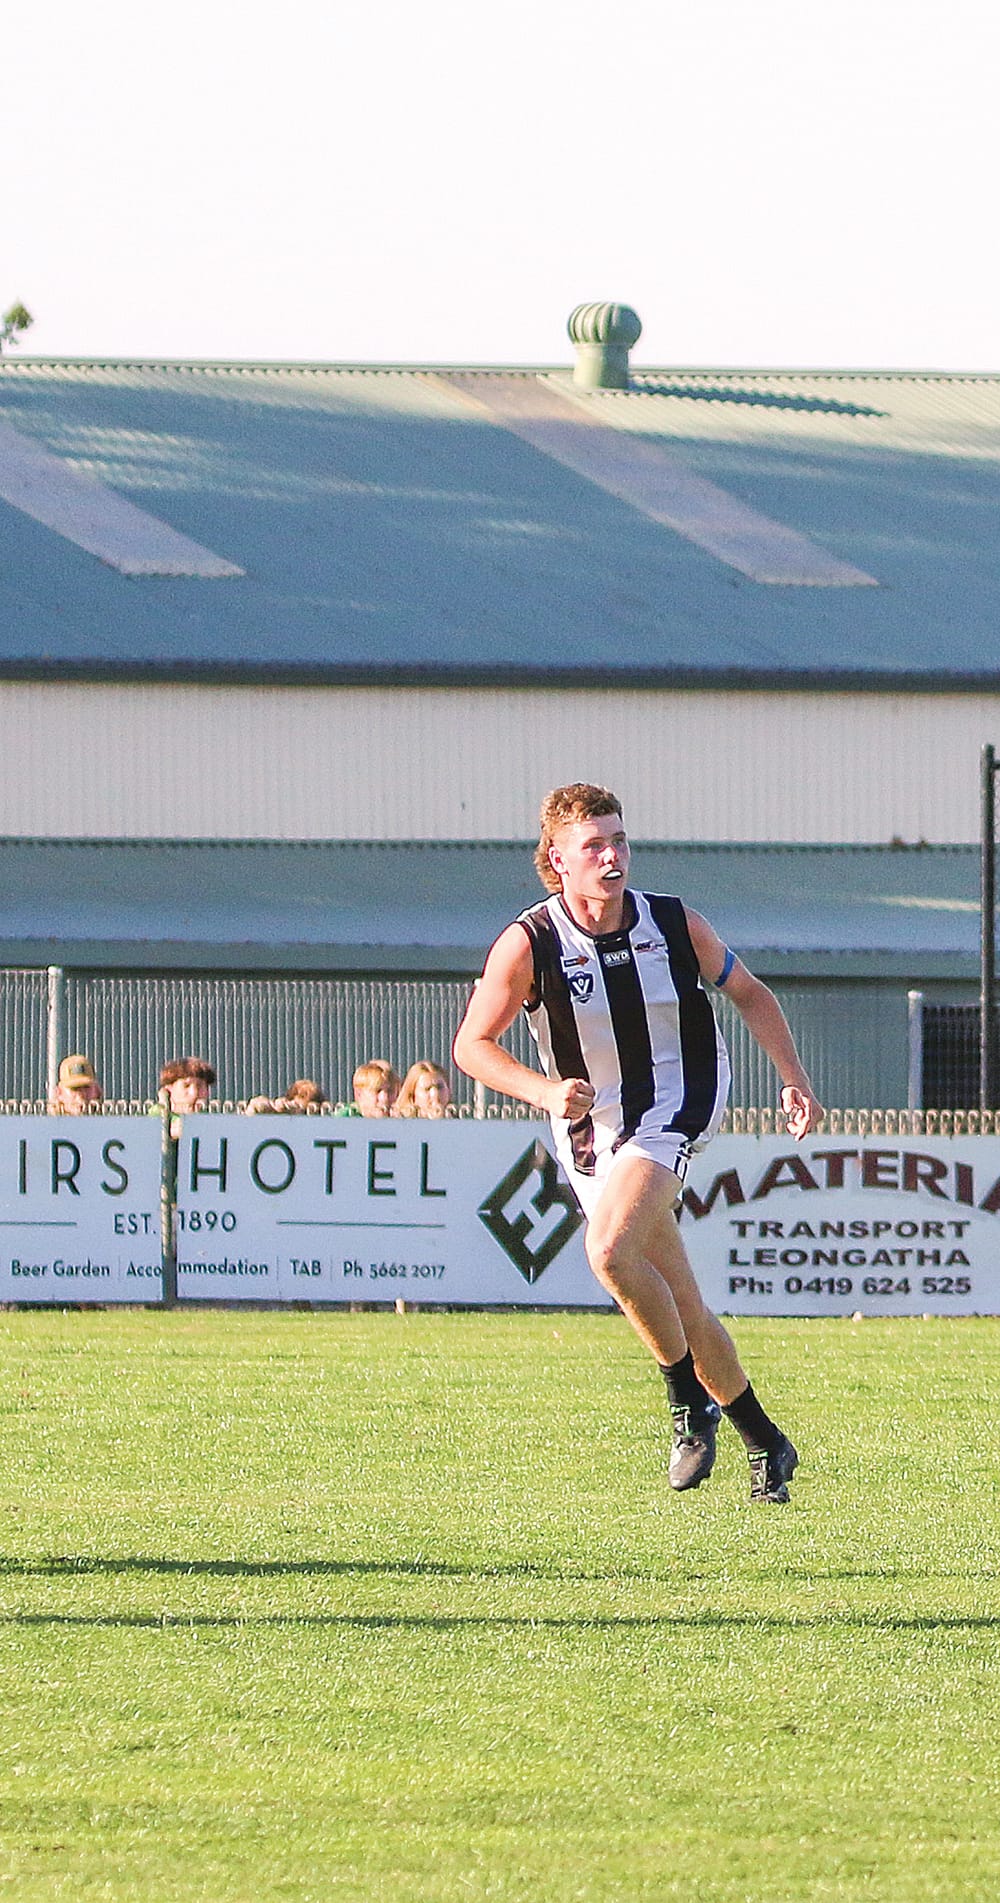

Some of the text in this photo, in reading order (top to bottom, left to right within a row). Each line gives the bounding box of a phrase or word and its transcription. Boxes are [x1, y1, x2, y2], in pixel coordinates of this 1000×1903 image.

[19, 1137, 446, 1197] IRS HOTEL
[113, 1210, 237, 1235] EST. 1890
[729, 1219, 971, 1239] TRANSPORT
[728, 1248, 971, 1267] LEONGATHA
[11, 1258, 48, 1277] Beer
[53, 1257, 110, 1278] Garden
[289, 1259, 322, 1277] TAB
[343, 1260, 363, 1278] Ph
[369, 1263, 408, 1279] 5662
[413, 1264, 445, 1280] 2017
[728, 1276, 972, 1295] Ph: 0419 624 525
